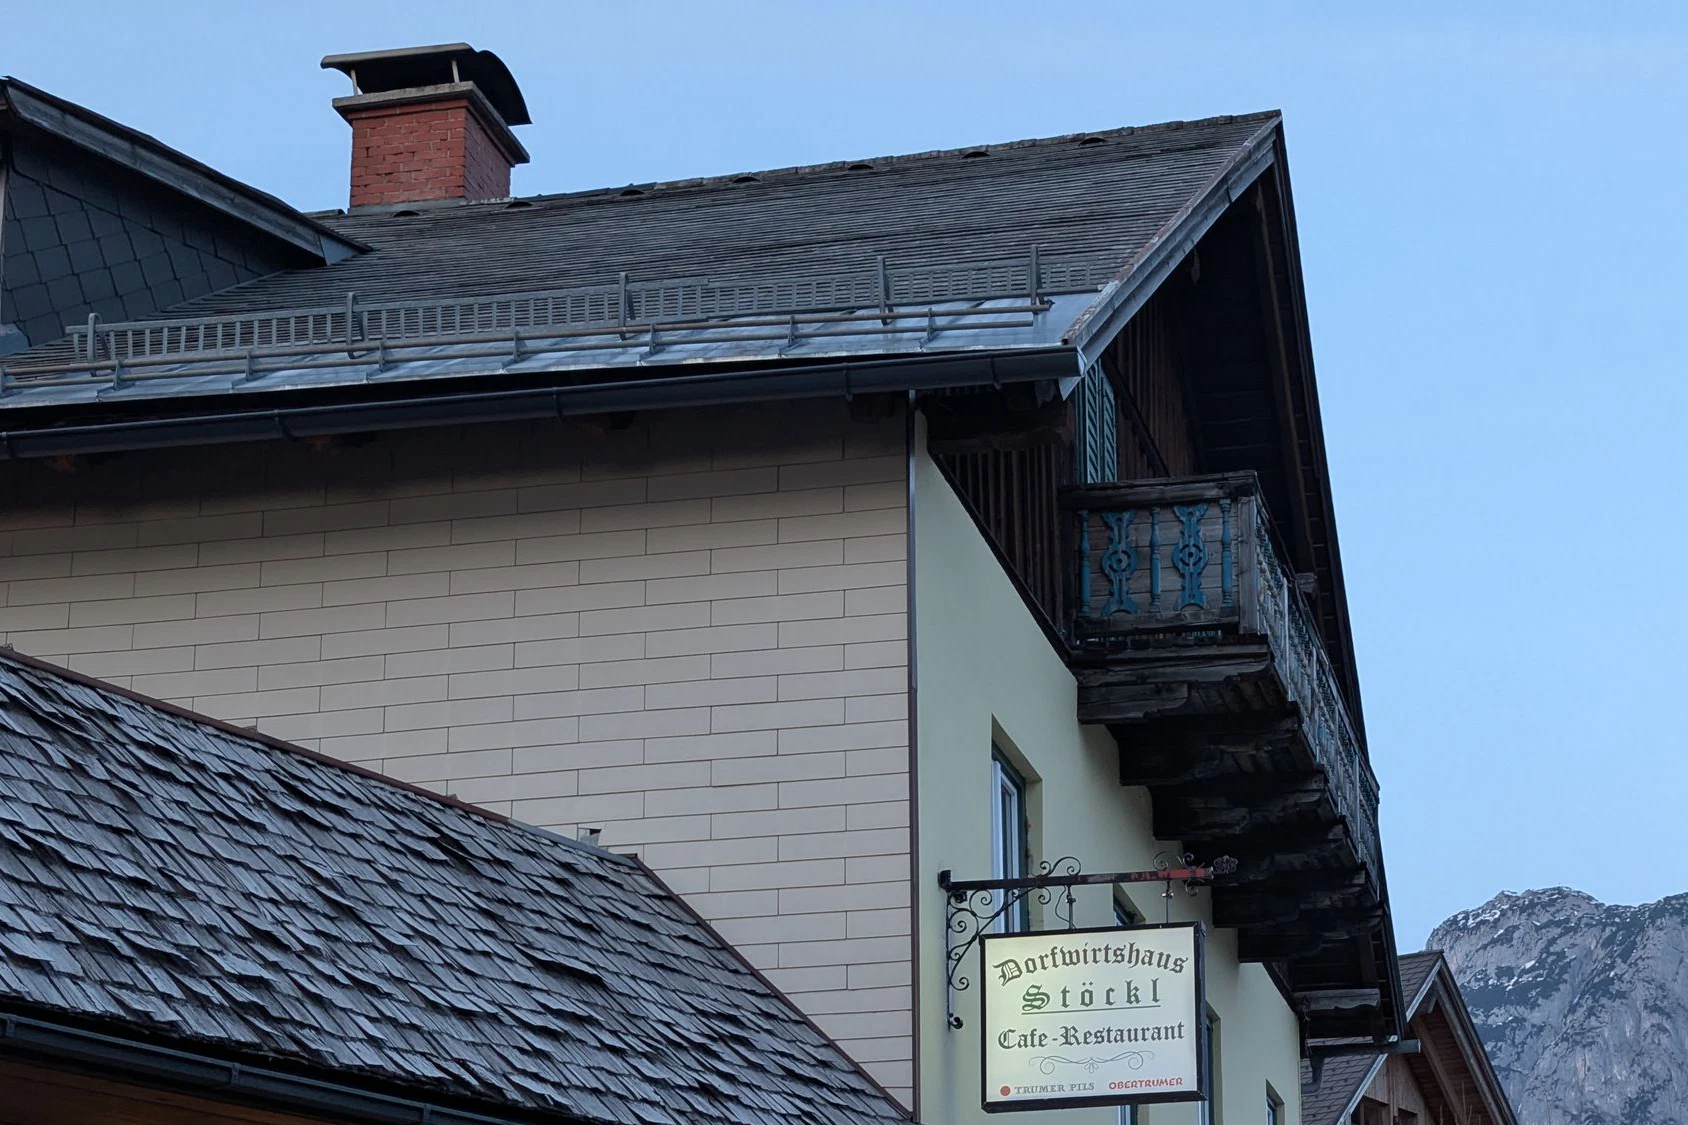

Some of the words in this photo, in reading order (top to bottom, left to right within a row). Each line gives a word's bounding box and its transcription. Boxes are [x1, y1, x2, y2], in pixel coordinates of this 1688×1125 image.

[992, 941, 1189, 987] Dorfwirtshaus
[1021, 977, 1161, 1012] Stöckl
[1014, 1083, 1066, 1095] TRUMER
[1069, 1081, 1095, 1092] PILS
[1108, 1077, 1184, 1090] OBERTRUMER
